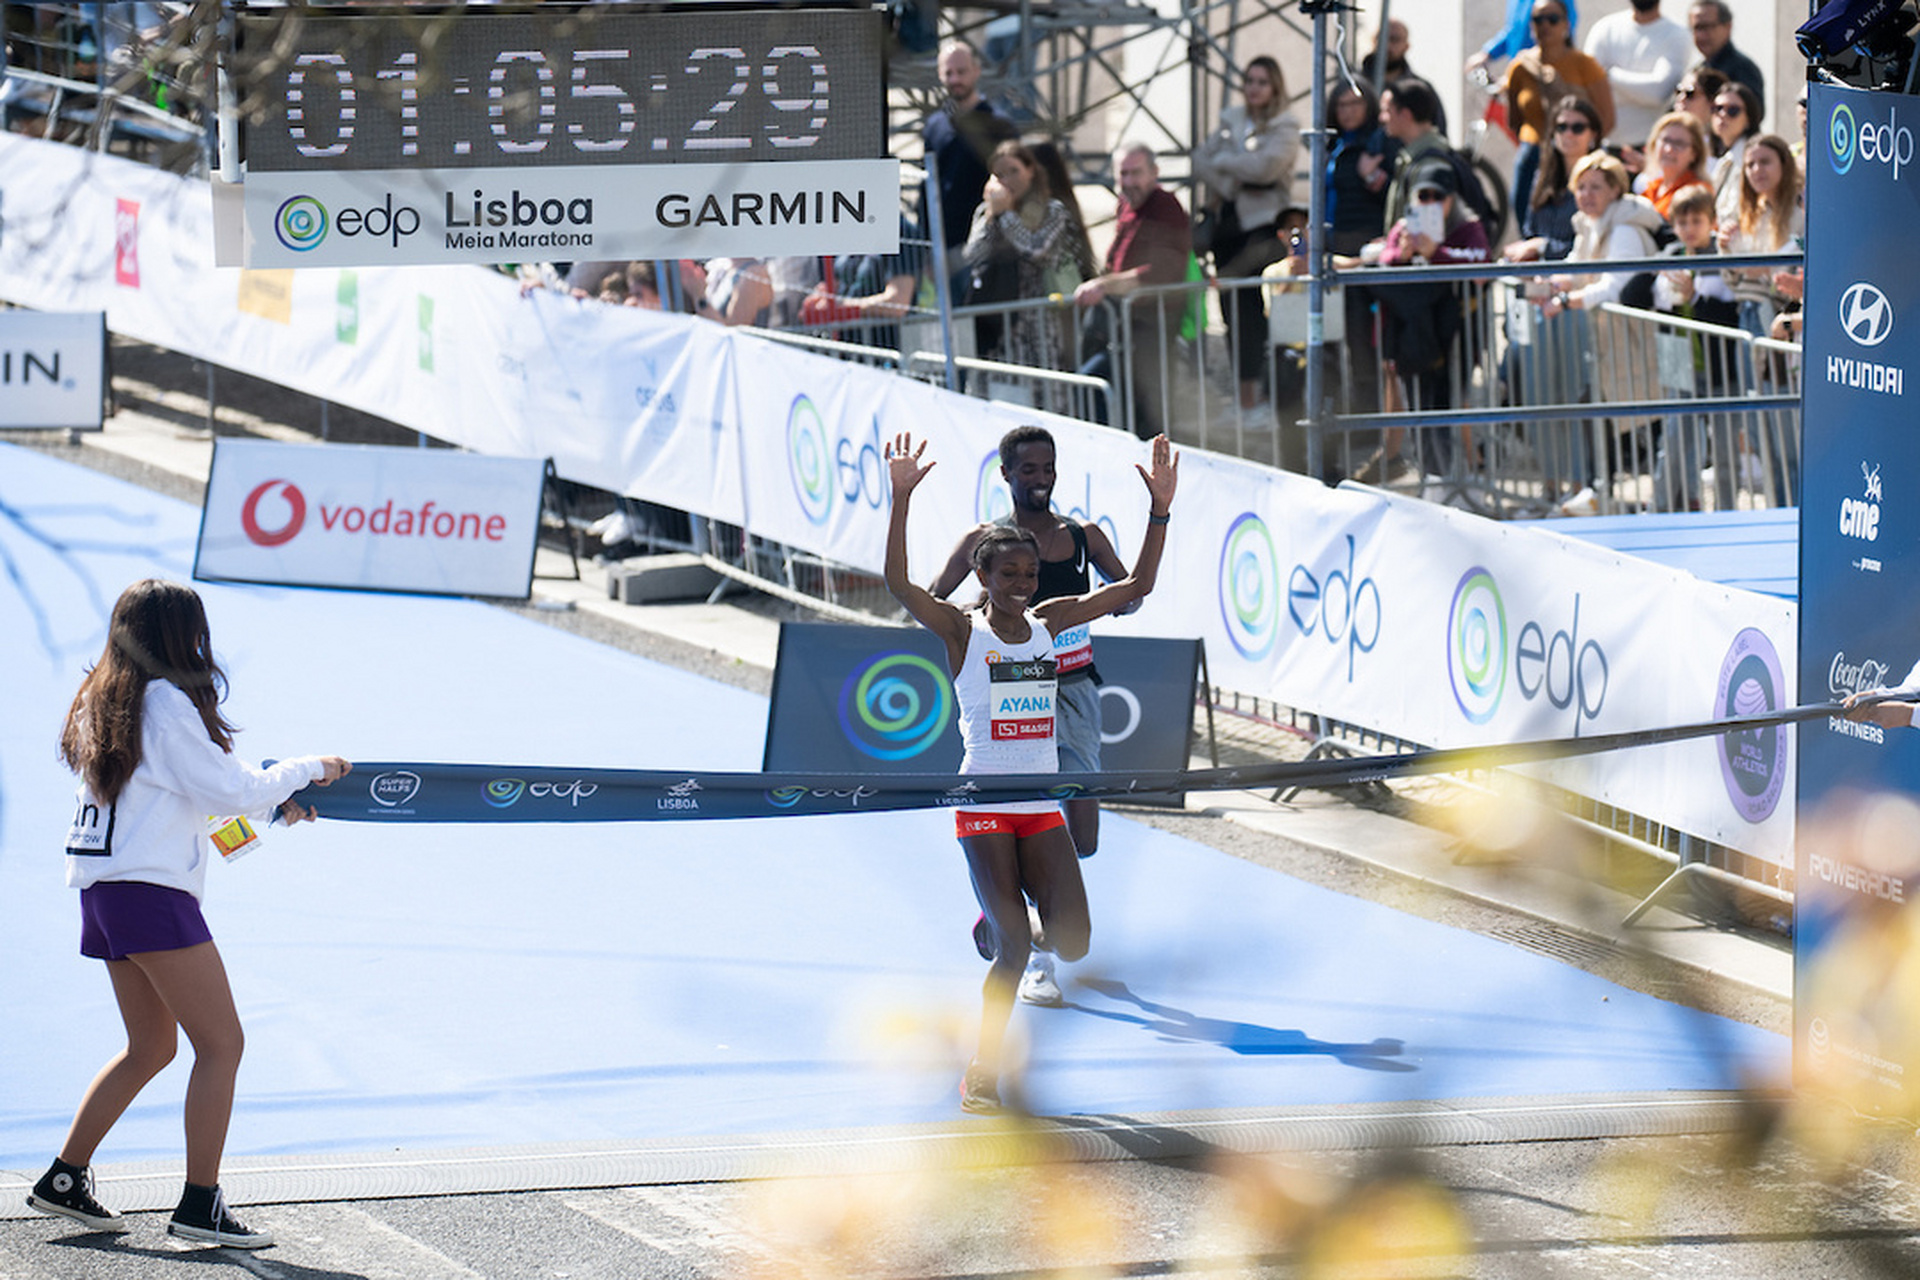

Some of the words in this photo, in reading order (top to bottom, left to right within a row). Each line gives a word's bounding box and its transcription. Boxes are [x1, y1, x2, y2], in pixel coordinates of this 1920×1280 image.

[1857, 1, 1887, 28] LYNX
[286, 46, 830, 158] 01:05:29
[1859, 105, 1914, 181] edp
[335, 192, 421, 248] edp
[445, 189, 594, 228] Lisboa
[655, 190, 867, 229] GARMIN
[445, 231, 495, 250] Meia
[499, 230, 594, 249] Maratona
[1827, 354, 1904, 397] HYUNDAI
[319, 498, 507, 542] vodafone
[1840, 497, 1881, 542] cme
[1287, 533, 1382, 684] edp
[1023, 663, 1046, 679] edp
[1515, 591, 1609, 739] edp
[998, 695, 1052, 714] AYANA
[1828, 715, 1885, 745] PARTNERS
[657, 798, 700, 810] LISBOA
[1808, 852, 1906, 905] POWERADE
